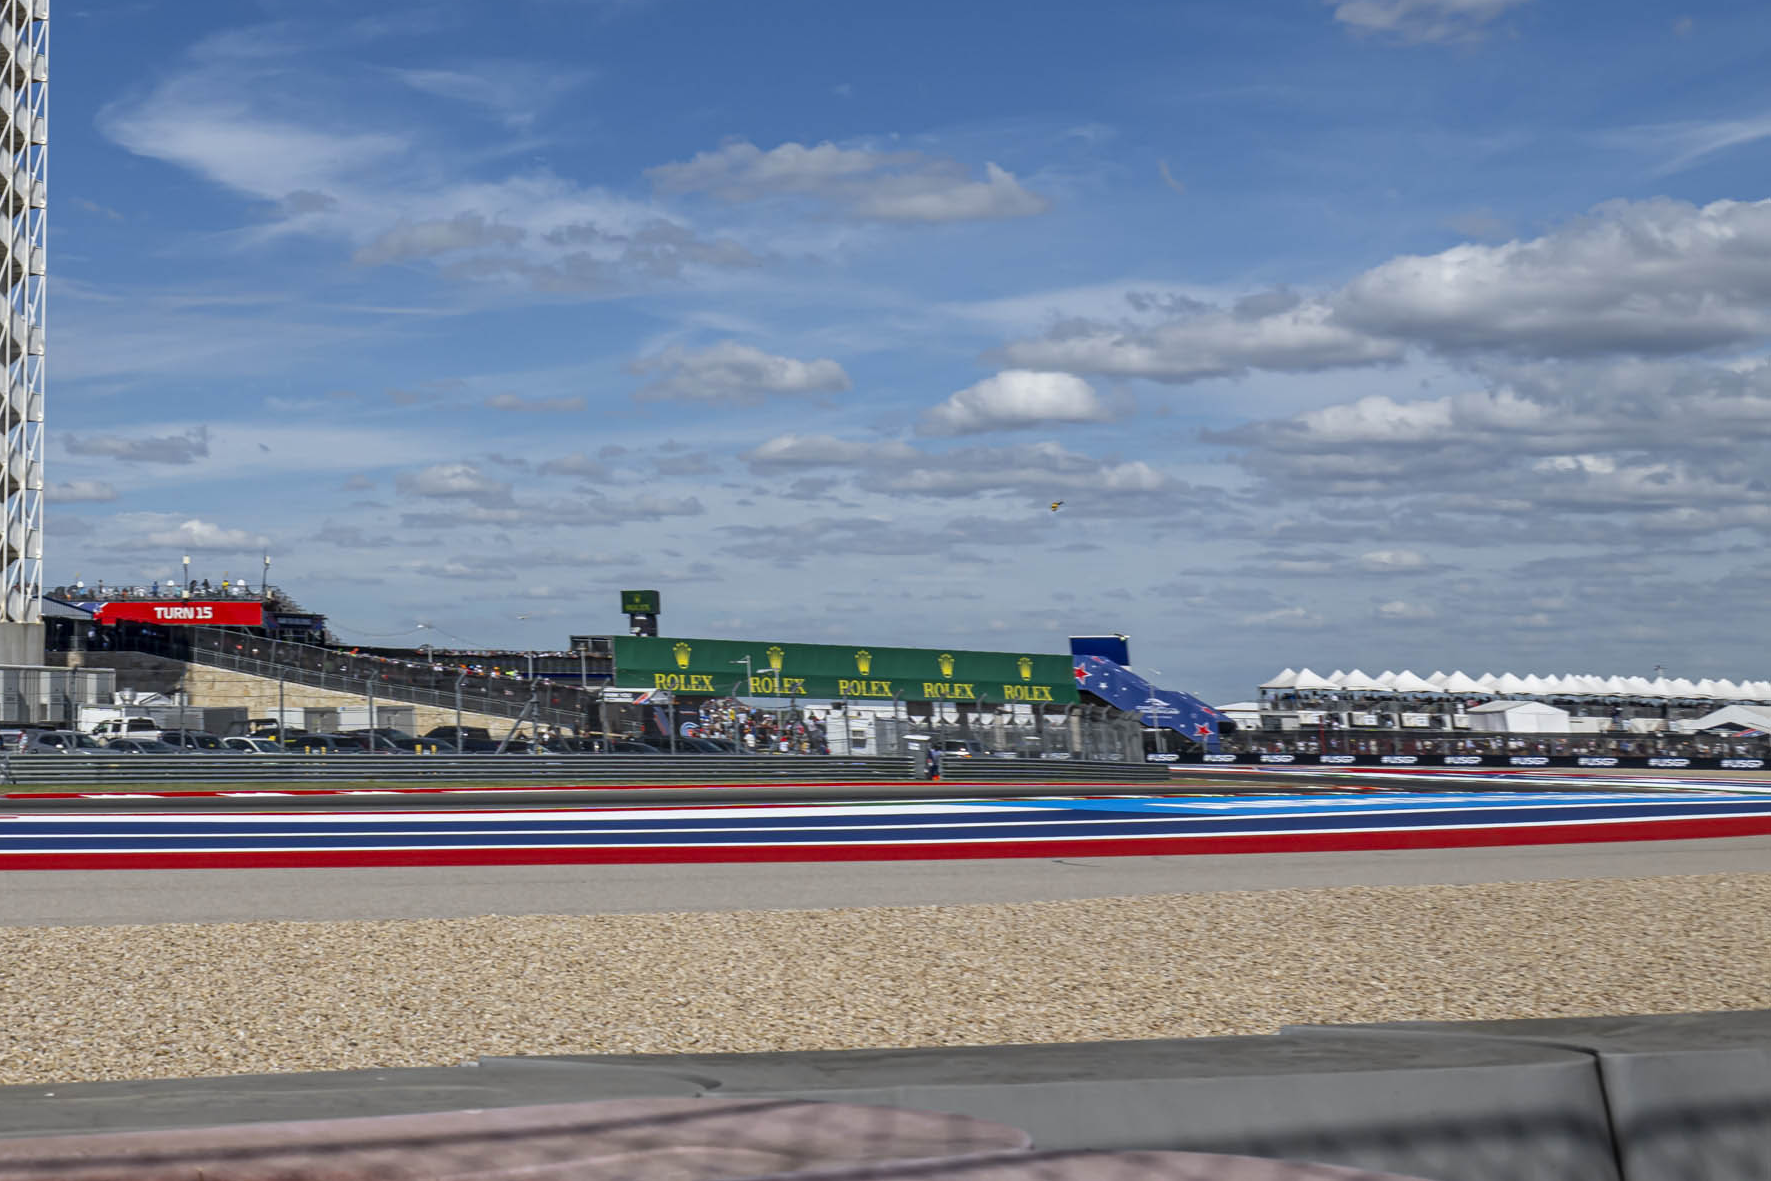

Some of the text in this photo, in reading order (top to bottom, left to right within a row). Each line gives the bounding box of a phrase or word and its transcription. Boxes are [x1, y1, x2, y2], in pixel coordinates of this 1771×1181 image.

[153, 606, 213, 620] TURN 15
[653, 673, 716, 692] ROLEX
[749, 676, 808, 695] ROLEX
[837, 679, 893, 697] ROLEX
[923, 682, 976, 699] ROLEX
[1003, 685, 1054, 701] ROLEX
